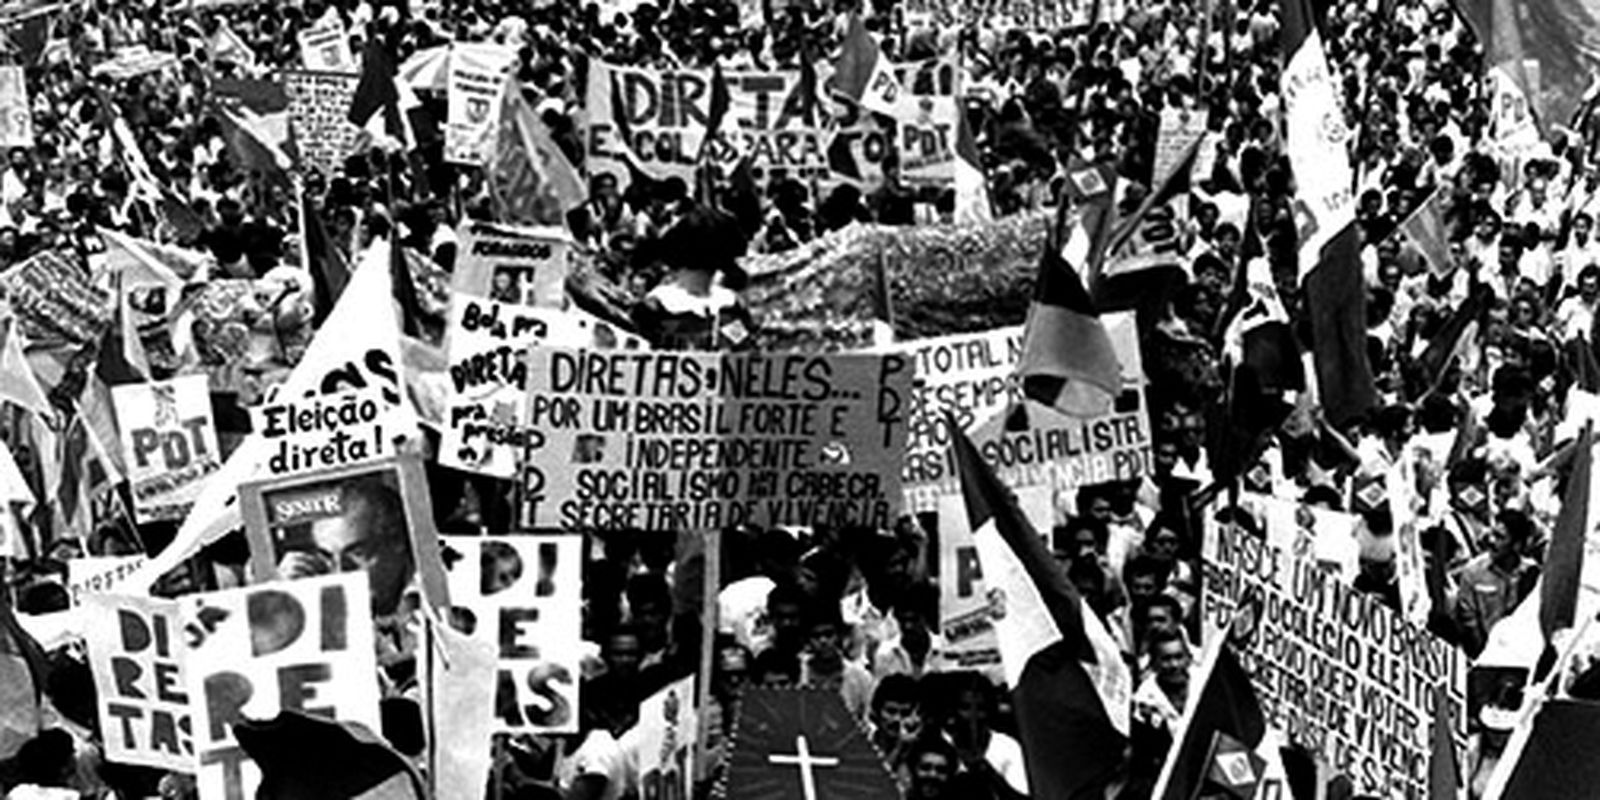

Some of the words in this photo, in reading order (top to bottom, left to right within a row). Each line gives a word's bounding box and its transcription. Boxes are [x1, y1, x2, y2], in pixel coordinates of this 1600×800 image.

[903, 123, 951, 157] PDT
[511, 314, 548, 338] pra
[916, 339, 1001, 376] TOTAL
[262, 394, 378, 439] Eleição
[450, 403, 487, 429] pra
[532, 394, 582, 429] POR
[592, 399, 629, 432] UM
[634, 397, 731, 434] BRASIL
[738, 403, 818, 436] FORTE
[829, 405, 849, 437] E
[130, 414, 208, 471] PDT
[982, 415, 1148, 467] SOCIALISTA
[1113, 446, 1154, 481] PDT
[576, 468, 739, 501] SOCIALISMO
[560, 499, 721, 529] SECRETARIA
[727, 500, 758, 528] DE
[117, 608, 170, 658] DI
[247, 584, 350, 659] DI
[1216, 526, 1283, 591] NASCE
[1292, 557, 1327, 613] UM
[1330, 577, 1387, 646] NOVO
[1389, 611, 1466, 700] BRASIL
[111, 656, 190, 705] RE
[1262, 624, 1306, 676] POVO
[1309, 652, 1358, 708] QUER
[1360, 682, 1421, 750] VOTAR
[1268, 591, 1280, 625] O
[1367, 646, 1470, 744] ELEITOAL
[203, 663, 333, 743] RE
[493, 663, 575, 728] AS
[1326, 700, 1351, 740] DE
